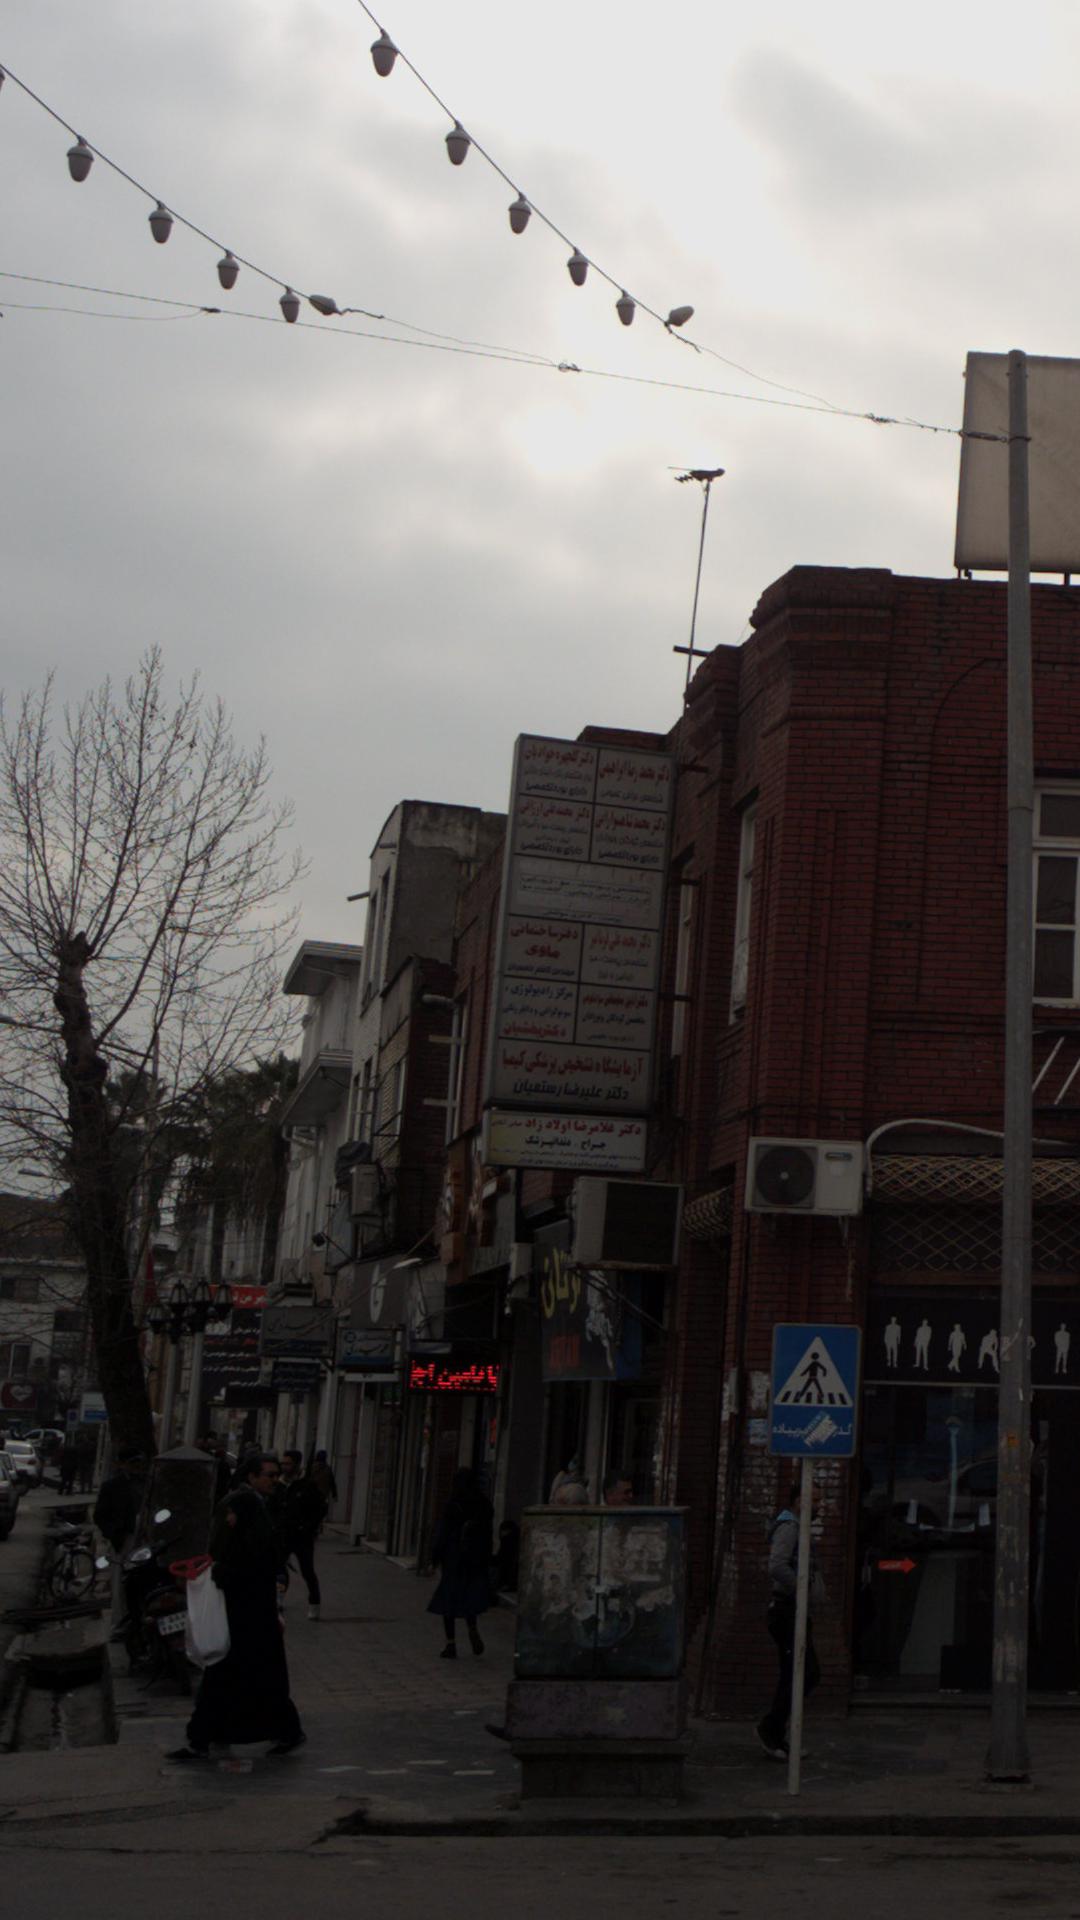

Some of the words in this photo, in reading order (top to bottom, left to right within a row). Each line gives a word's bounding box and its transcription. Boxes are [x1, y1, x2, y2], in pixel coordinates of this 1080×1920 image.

[605, 1085, 629, 1102] دکتر
[574, 1120, 615, 1136] غلامرضا
[618, 1123, 641, 1138] دکتر
[580, 1139, 606, 1152] جراح
